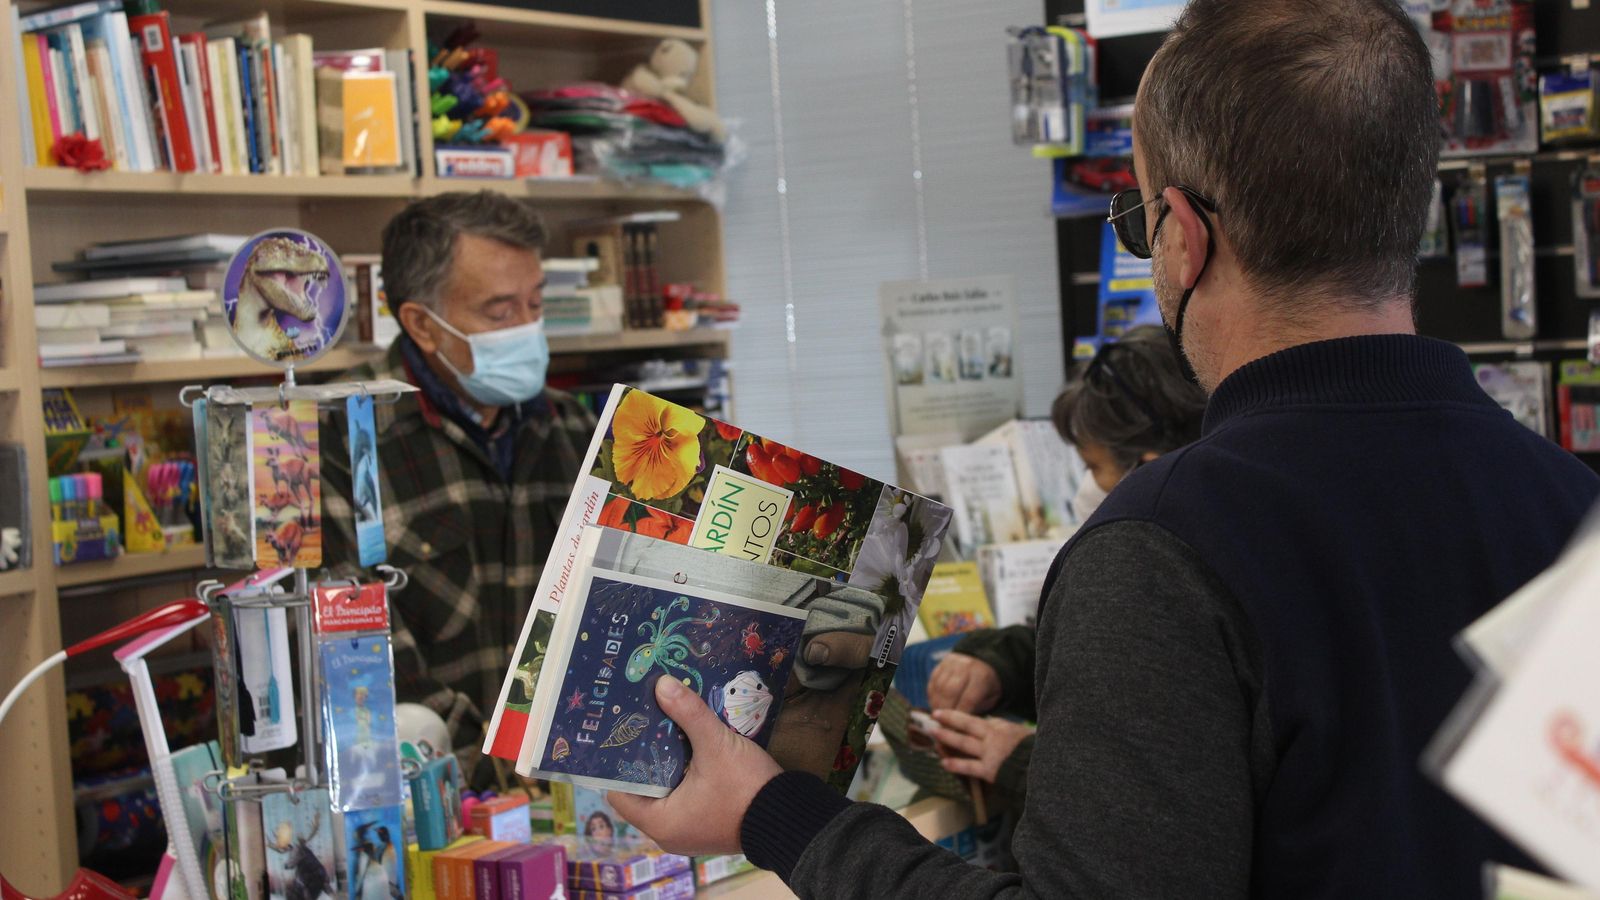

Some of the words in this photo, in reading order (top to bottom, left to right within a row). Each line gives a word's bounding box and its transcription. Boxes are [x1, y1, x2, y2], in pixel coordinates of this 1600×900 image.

[549, 552, 575, 604] Plantas
[571, 534, 581, 550] de
[322, 605, 334, 617] El
[335, 603, 382, 617] Principito
[878, 629, 896, 665] susaeta
[576, 612, 629, 743] FELICIDADES
